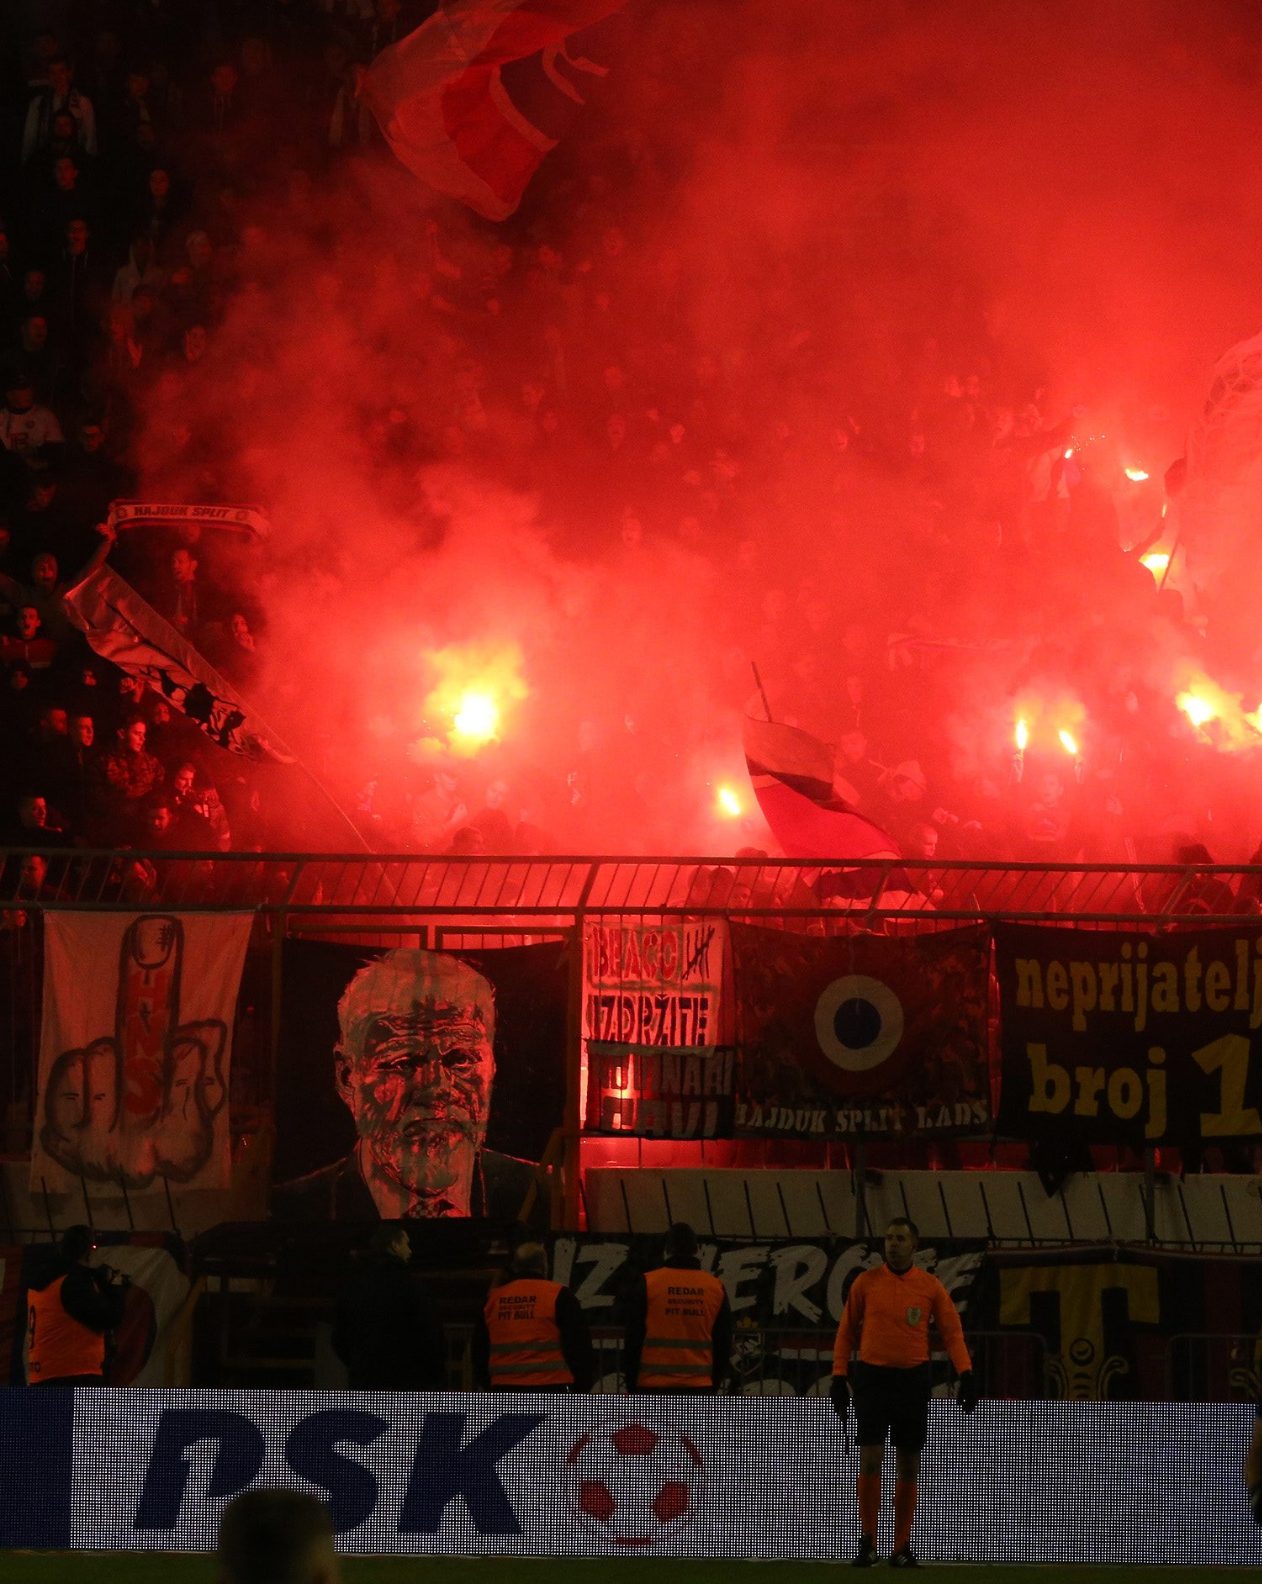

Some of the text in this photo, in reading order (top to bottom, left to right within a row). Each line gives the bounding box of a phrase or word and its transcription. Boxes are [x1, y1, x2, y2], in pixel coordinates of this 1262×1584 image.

[192, 507, 230, 519] SPLIT
[1026, 1042, 1168, 1139] broj
[834, 1108, 906, 1133] SPLIT
[914, 1102, 988, 1129] LADS
[499, 1295, 537, 1304] REDAR
[667, 1286, 705, 1296] REDAR
[133, 1408, 548, 1535] PSK
